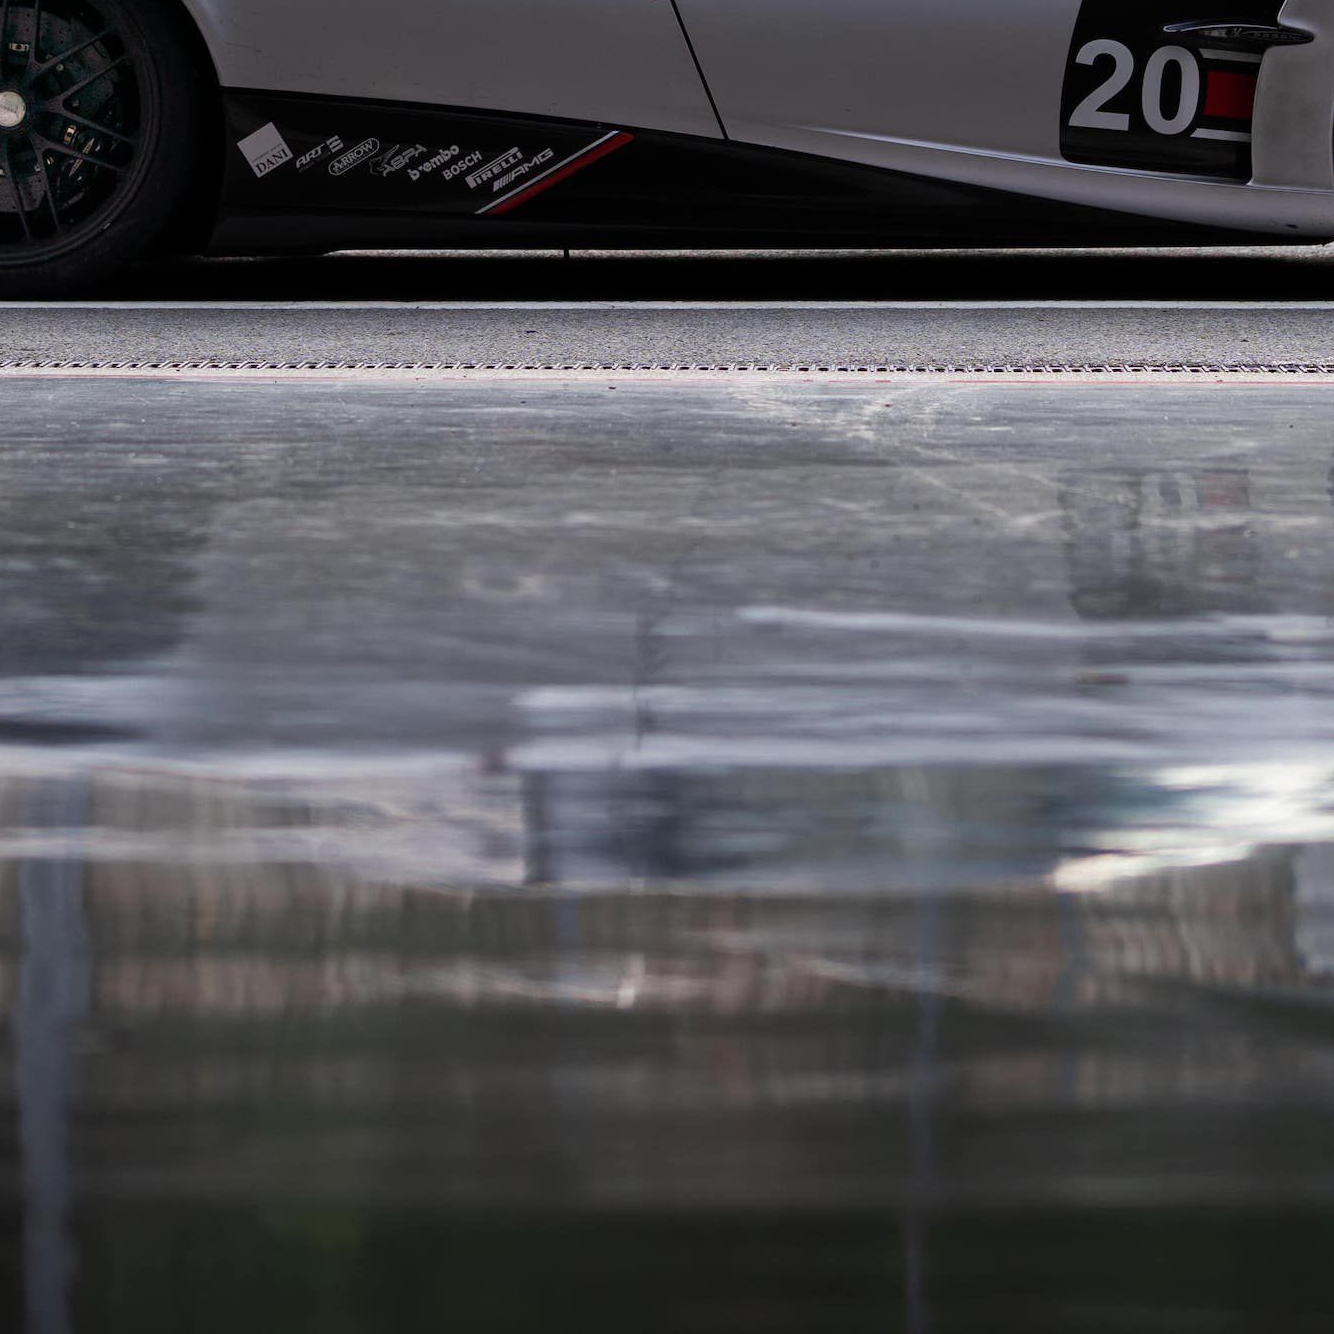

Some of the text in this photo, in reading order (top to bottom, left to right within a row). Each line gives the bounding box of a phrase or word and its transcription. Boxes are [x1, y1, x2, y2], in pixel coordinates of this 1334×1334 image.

[1068, 38, 1200, 136] 20
[255, 148, 289, 173] DANI
[405, 144, 460, 182] brembo
[441, 149, 484, 181] BOSCH
[465, 146, 524, 189] PIRELLI
